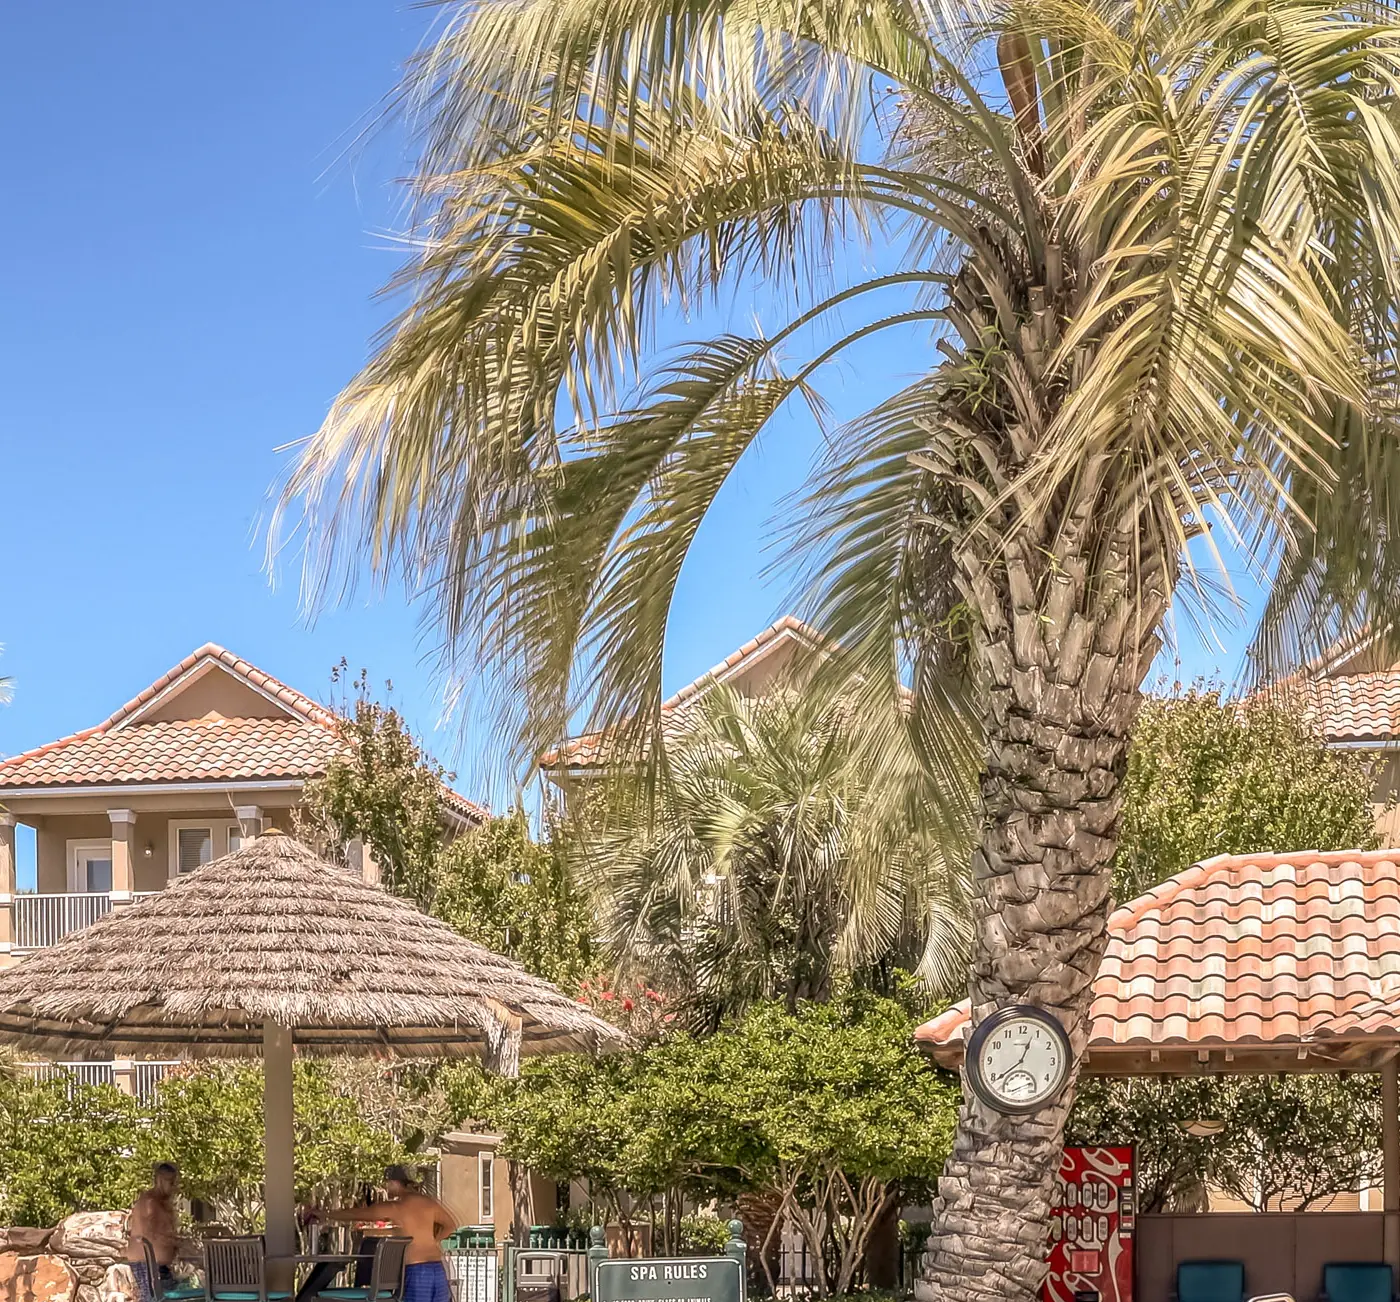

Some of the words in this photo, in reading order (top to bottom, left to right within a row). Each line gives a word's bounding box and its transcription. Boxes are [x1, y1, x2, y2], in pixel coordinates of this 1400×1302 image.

[1018, 1026, 1028, 1034] 12
[1036, 1030, 1040, 1038] 1
[1004, 1030, 1012, 1039] 11
[992, 1042, 1001, 1050] 10
[1046, 1042, 1051, 1050] 2
[987, 1056, 992, 1065] 9
[1050, 1057, 1055, 1066] 3
[990, 1073, 996, 1082] 8
[1044, 1074, 1049, 1082] 4
[630, 1266, 657, 1281] SPA
[664, 1265, 708, 1280] RULES
